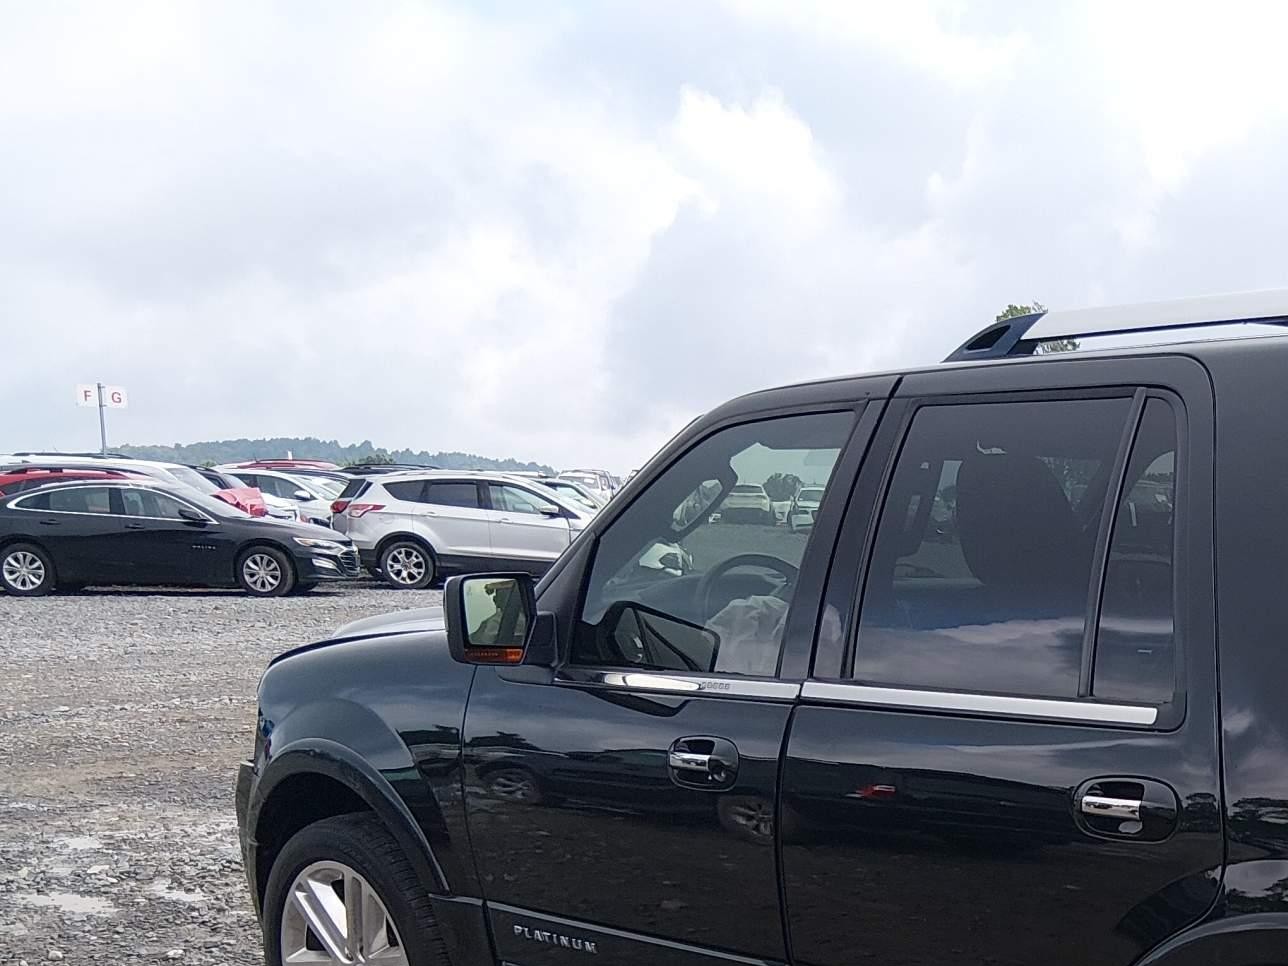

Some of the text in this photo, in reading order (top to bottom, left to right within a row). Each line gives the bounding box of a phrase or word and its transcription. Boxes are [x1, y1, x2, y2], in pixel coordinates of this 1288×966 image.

[83, 390, 92, 402] F
[111, 391, 122, 404] G
[513, 925, 598, 954] PLATINUM
